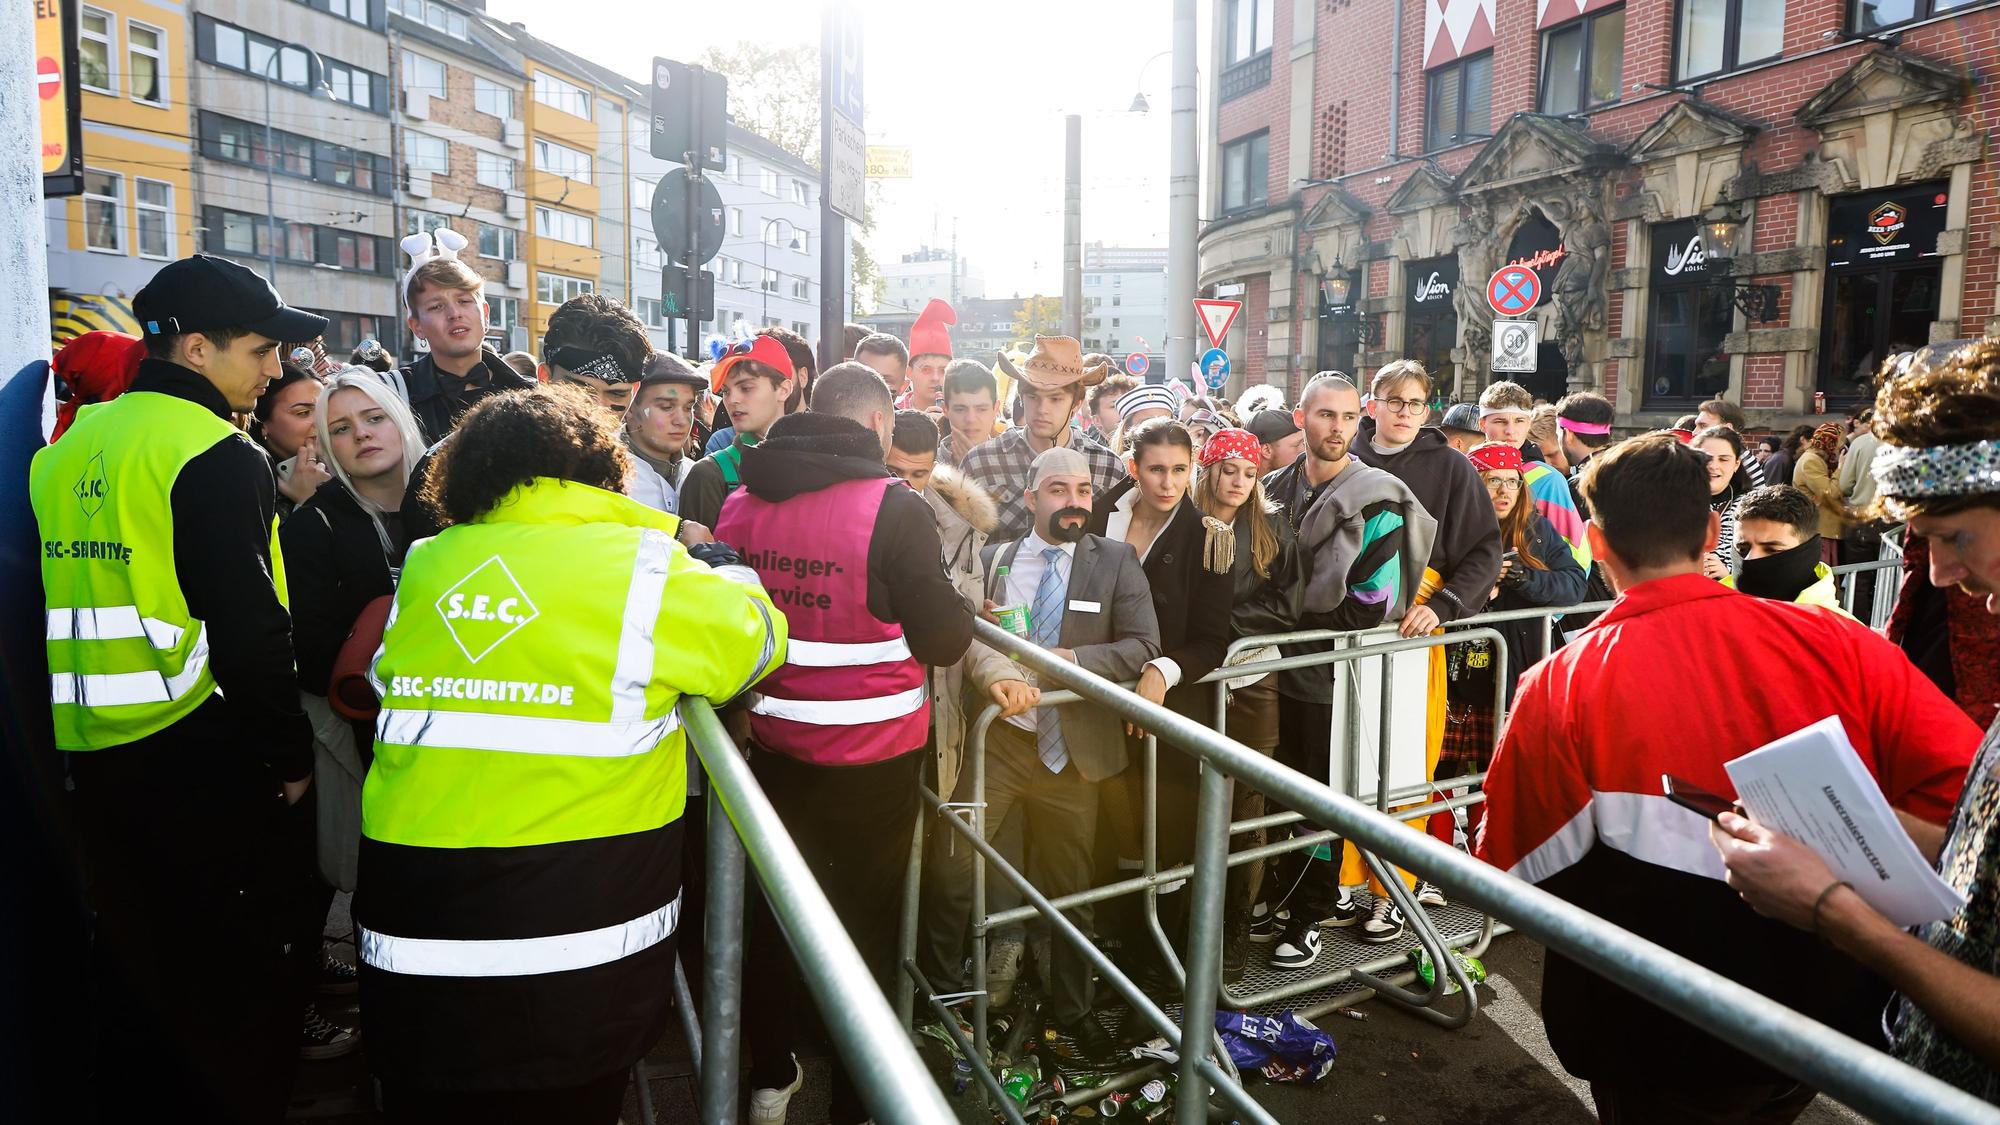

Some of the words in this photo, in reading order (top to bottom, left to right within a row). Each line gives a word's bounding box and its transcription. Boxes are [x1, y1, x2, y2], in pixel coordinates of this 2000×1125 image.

[834, 119, 864, 158] Parkschein
[1684, 264, 1707, 272] KÖLSC
[1414, 271, 1449, 302] Sion
[1506, 333, 1524, 349] 30
[447, 593, 525, 624] S.E.C.
[767, 586, 832, 609] rvice
[391, 676, 575, 706] SEC-SECURITY.DE
[1822, 785, 1891, 882] Untermietvertrag
